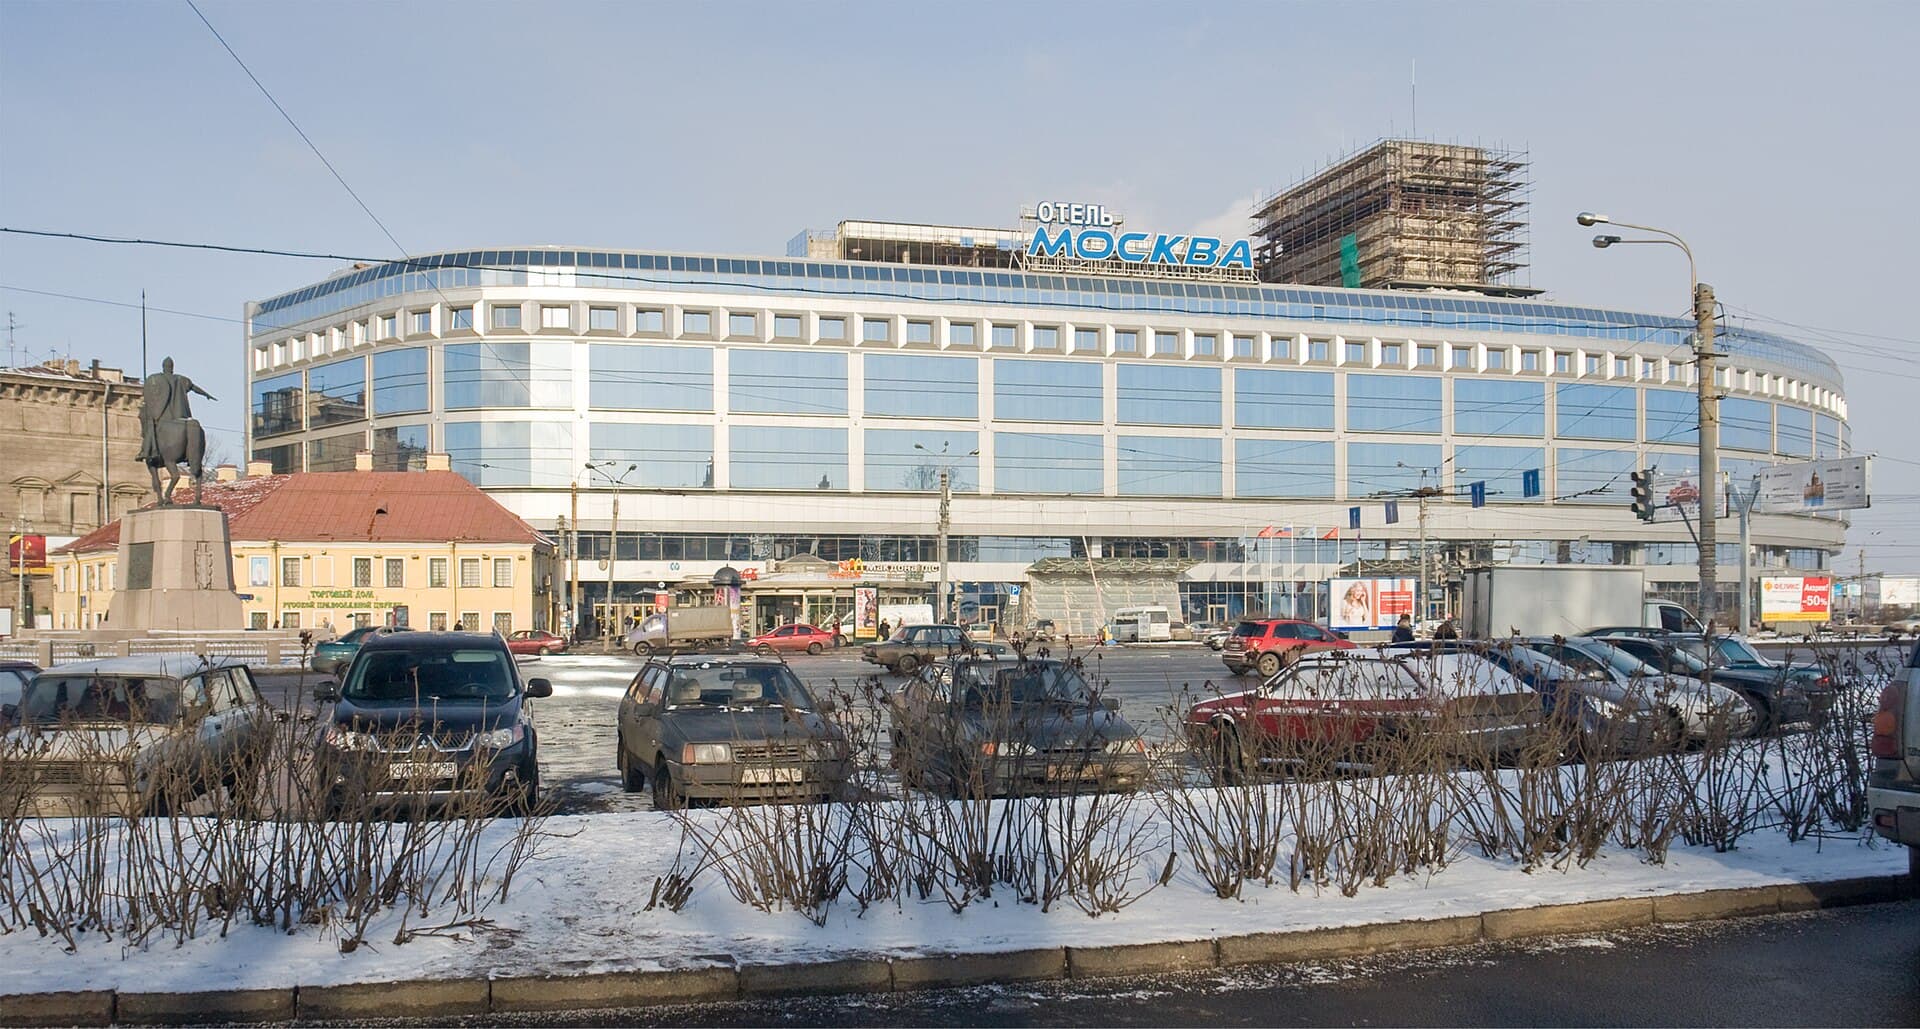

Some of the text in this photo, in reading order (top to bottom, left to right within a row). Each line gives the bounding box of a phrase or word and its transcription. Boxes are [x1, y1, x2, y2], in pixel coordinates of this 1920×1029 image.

[1037, 201, 1114, 227] ОТЕЛЬ
[1027, 226, 1254, 270] МОСКВА
[310, 590, 374, 599] ТОРГОВЫЙ ДОМ
[1802, 595, 1828, 606] -50%
